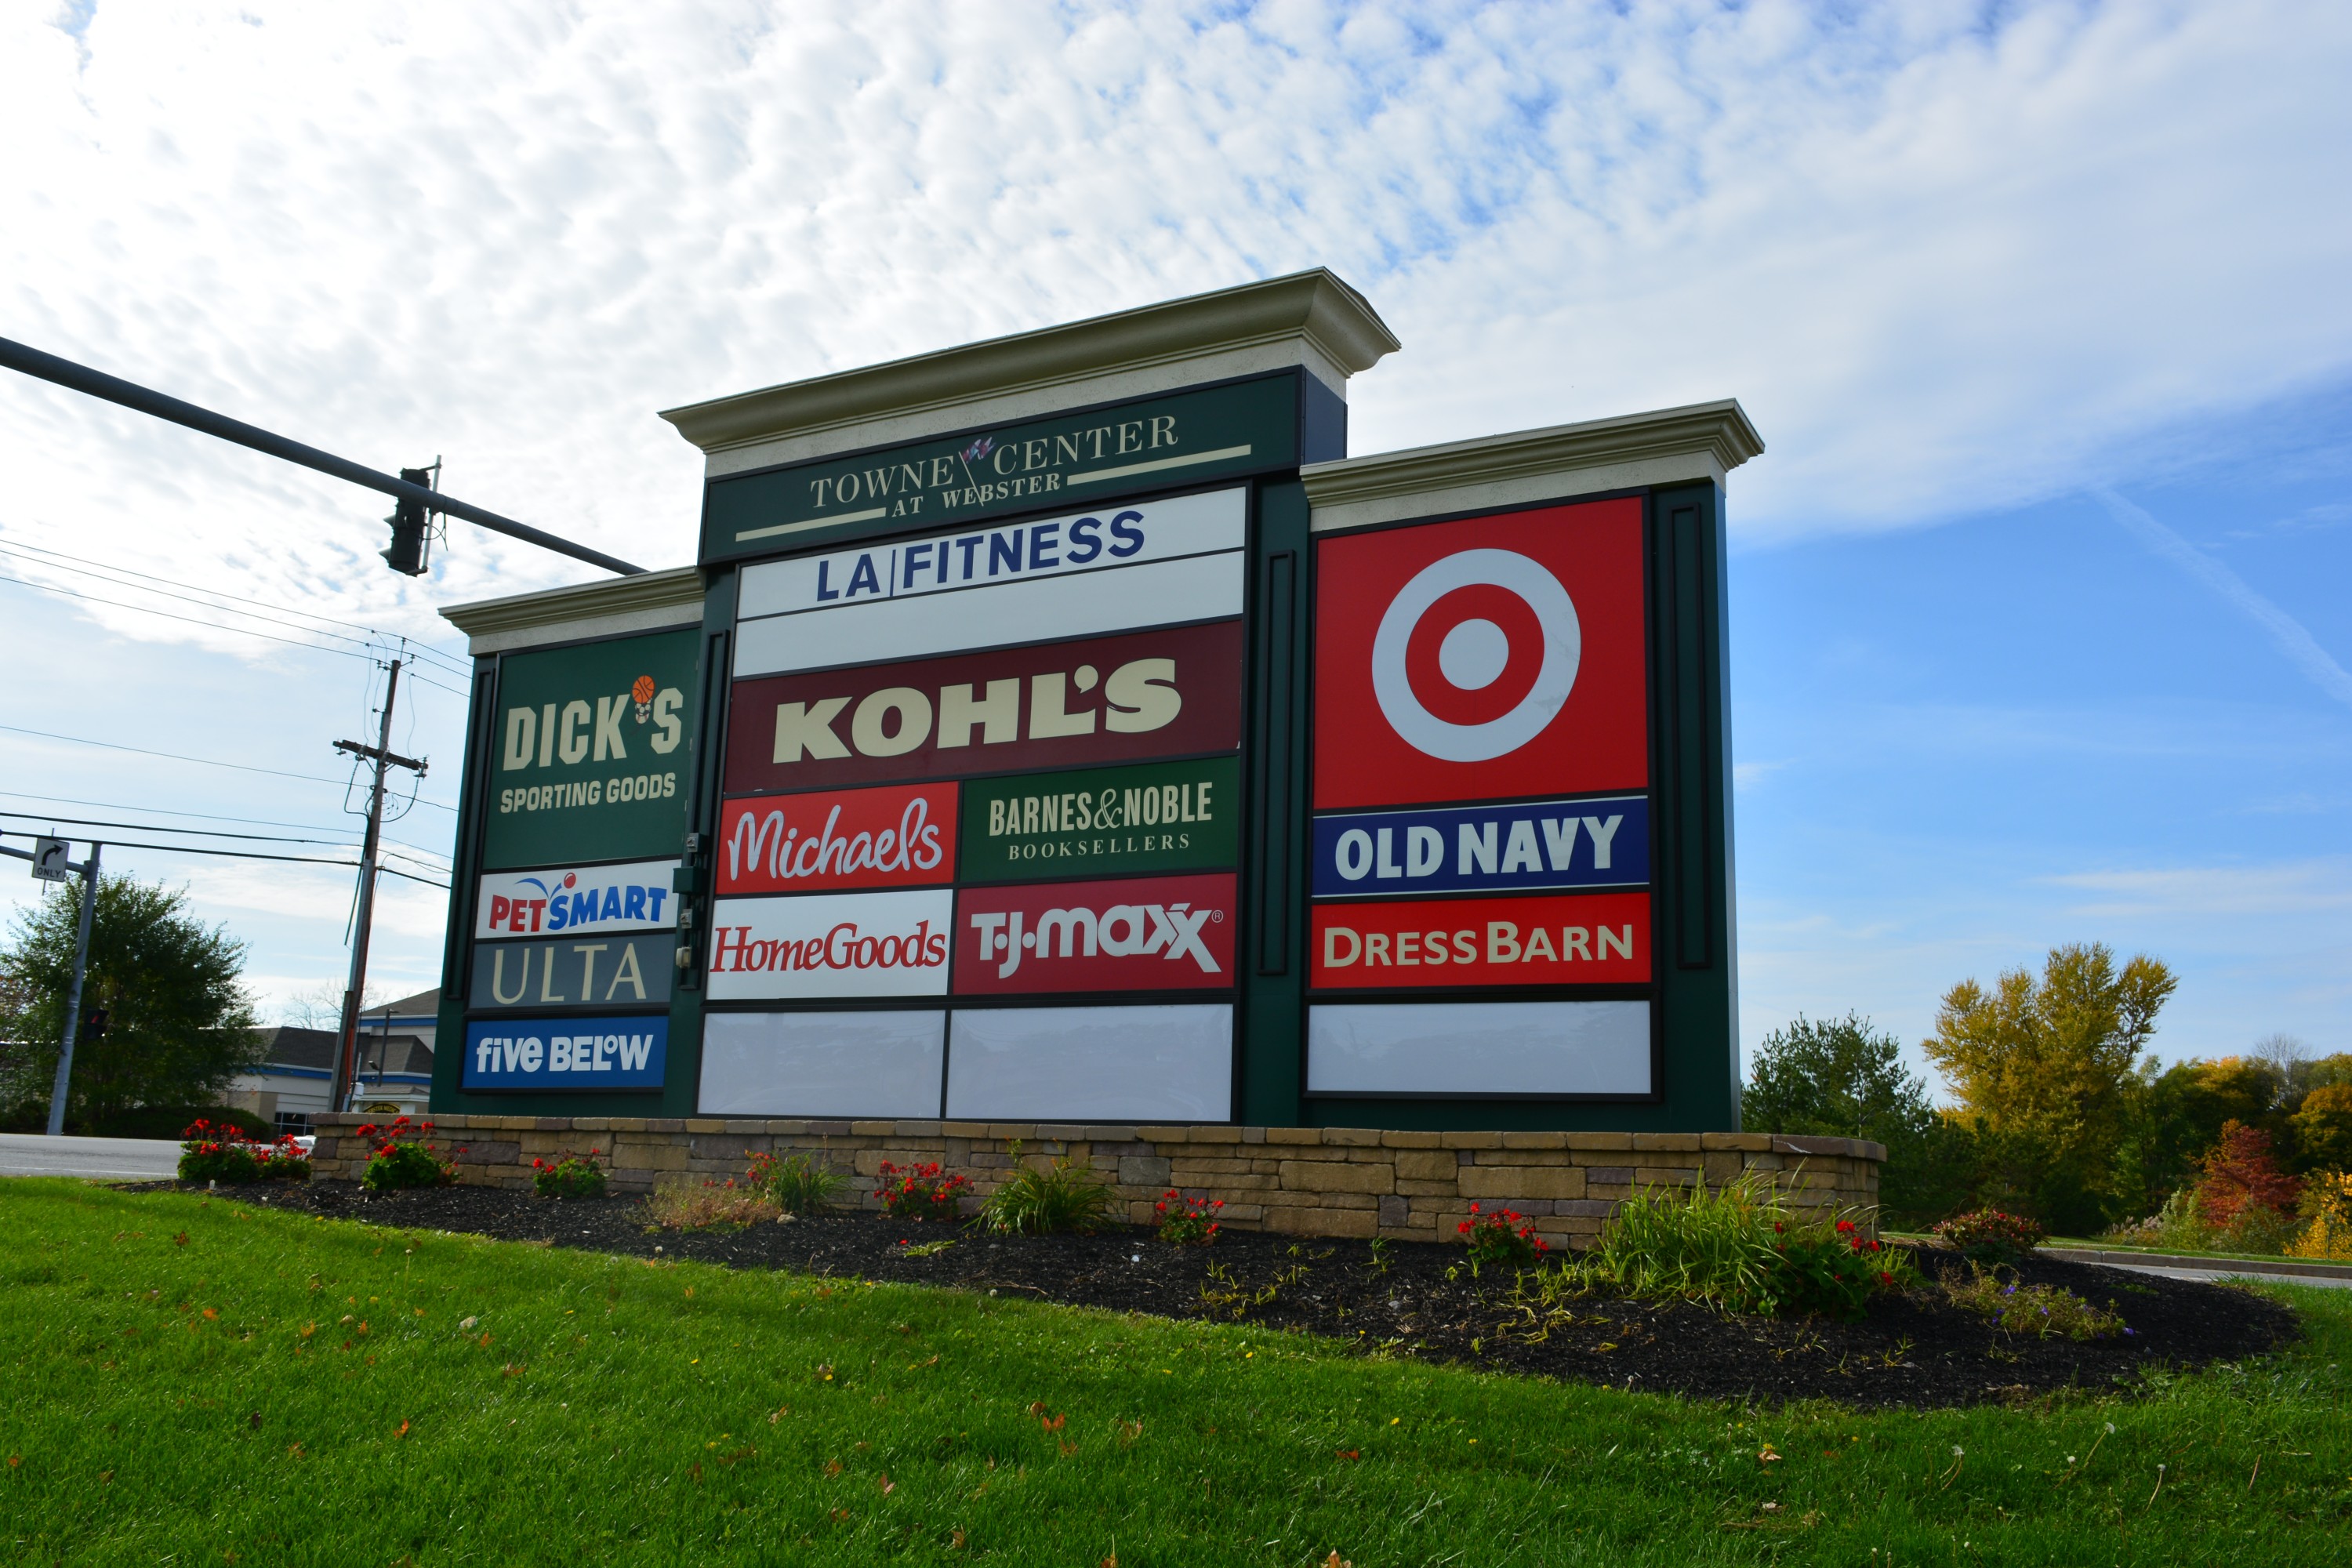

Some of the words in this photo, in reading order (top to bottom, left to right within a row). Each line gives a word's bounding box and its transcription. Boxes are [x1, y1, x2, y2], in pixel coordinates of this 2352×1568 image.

[810, 455, 954, 508] TOWNE
[993, 415, 1178, 475] CENTER
[891, 495, 924, 517] AT
[942, 473, 1061, 509] WEBSTER
[902, 510, 1145, 589] FITNESS
[503, 686, 684, 771] DICK'S
[772, 657, 1182, 764] KOHL'S
[500, 780, 601, 813] SPORTING
[606, 772, 676, 803] GOODS
[728, 797, 942, 880] Michaels
[1007, 833, 1190, 860] BOOKSELLERS
[1335, 826, 1444, 880] OLD
[1457, 815, 1624, 875] NAVY
[37, 867, 61, 878] ONLY
[492, 942, 648, 1005] ULTA
[709, 920, 946, 973] HomeGoods
